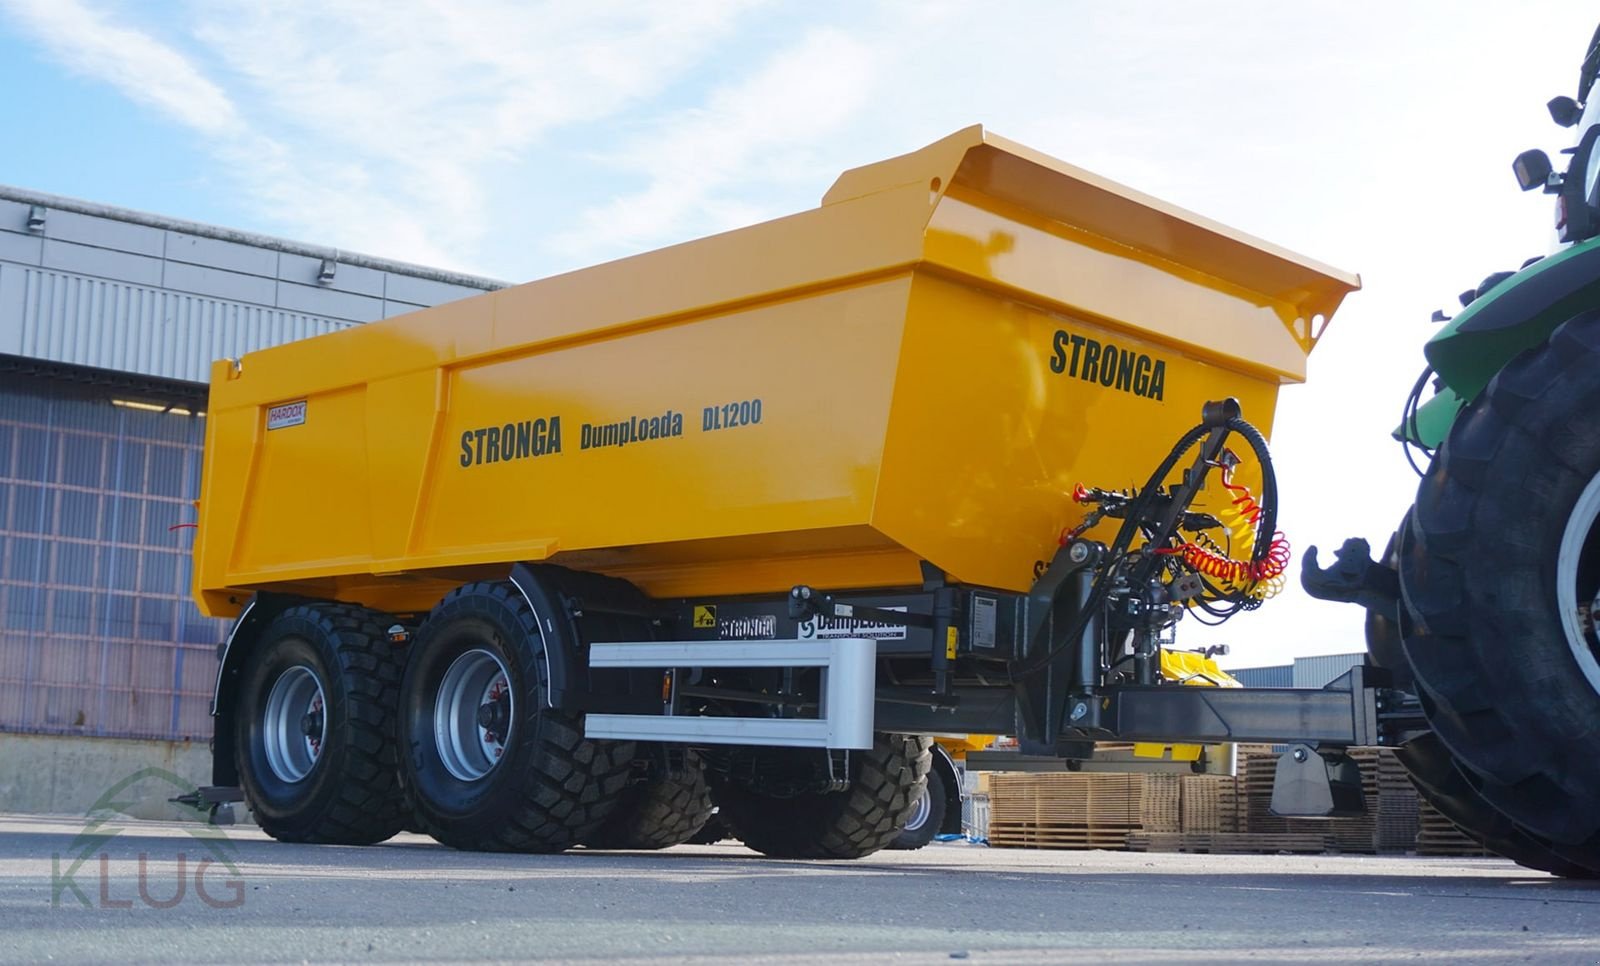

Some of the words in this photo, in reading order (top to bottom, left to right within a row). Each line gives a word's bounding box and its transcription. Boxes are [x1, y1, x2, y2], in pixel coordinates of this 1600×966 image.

[1050, 330, 1166, 402] STRONGA
[270, 404, 305, 422] HARDOX
[460, 416, 562, 468] STRONGA
[580, 410, 683, 450] DumpLoada
[702, 399, 763, 432] DL1200
